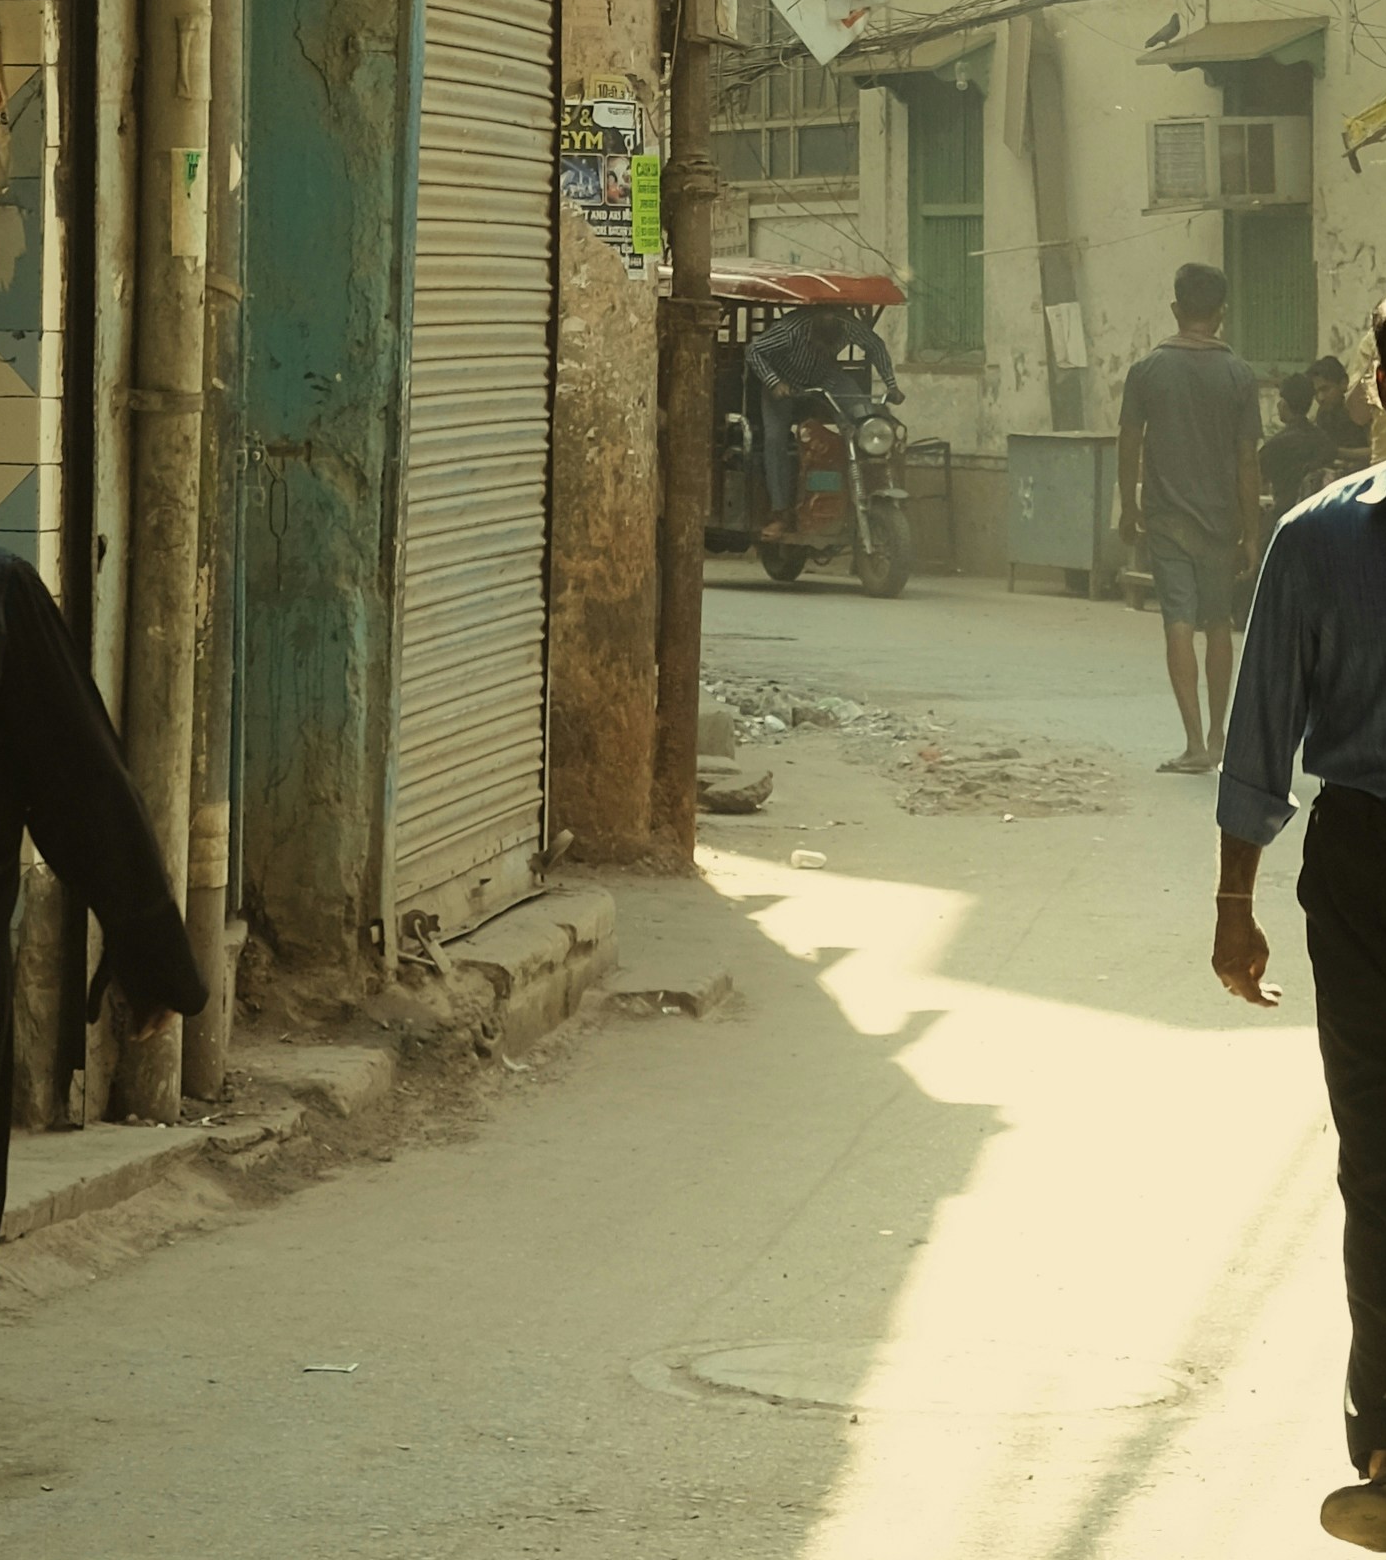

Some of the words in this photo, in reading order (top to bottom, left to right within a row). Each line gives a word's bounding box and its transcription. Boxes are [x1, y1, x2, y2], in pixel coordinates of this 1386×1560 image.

[580, 109, 593, 126] &
[560, 130, 603, 150] GYM
[590, 210, 608, 220] AND
